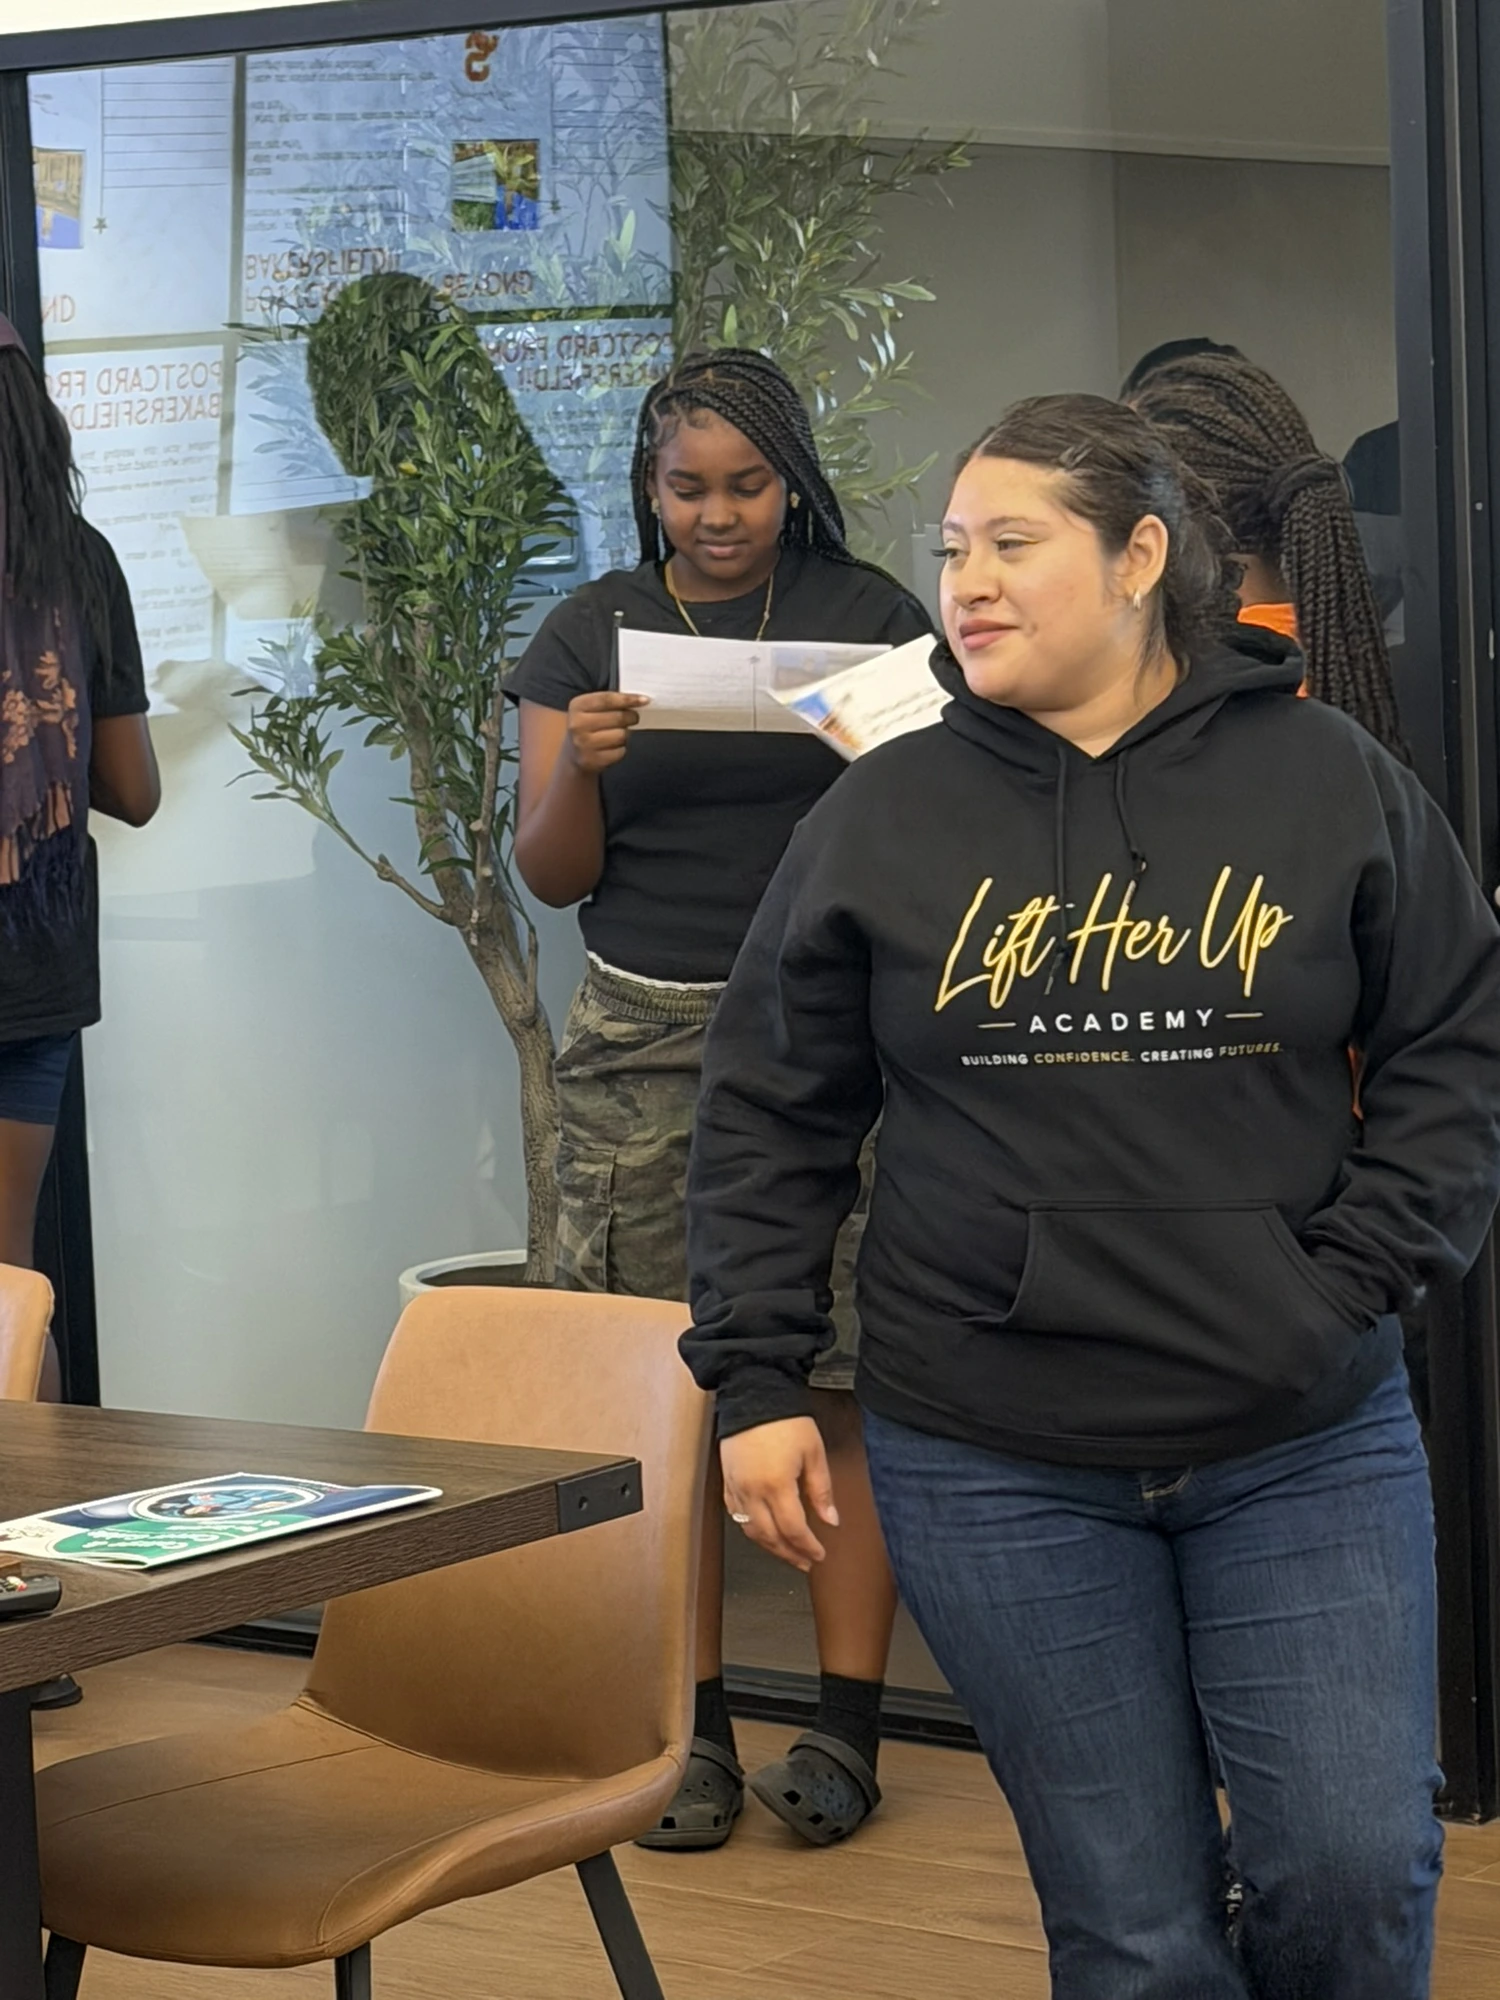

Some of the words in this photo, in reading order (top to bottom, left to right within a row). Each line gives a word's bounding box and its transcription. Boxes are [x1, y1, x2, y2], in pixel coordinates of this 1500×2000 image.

[935, 877, 1072, 1011] Lift
[1067, 873, 1191, 992] Her
[1200, 865, 1294, 997] Up
[1029, 1008, 1214, 1033] ACADEMY
[961, 1053, 1029, 1066] BUILDING
[1033, 1051, 1135, 1064] CONFIDENCE.
[1140, 1047, 1214, 1063] CREATING
